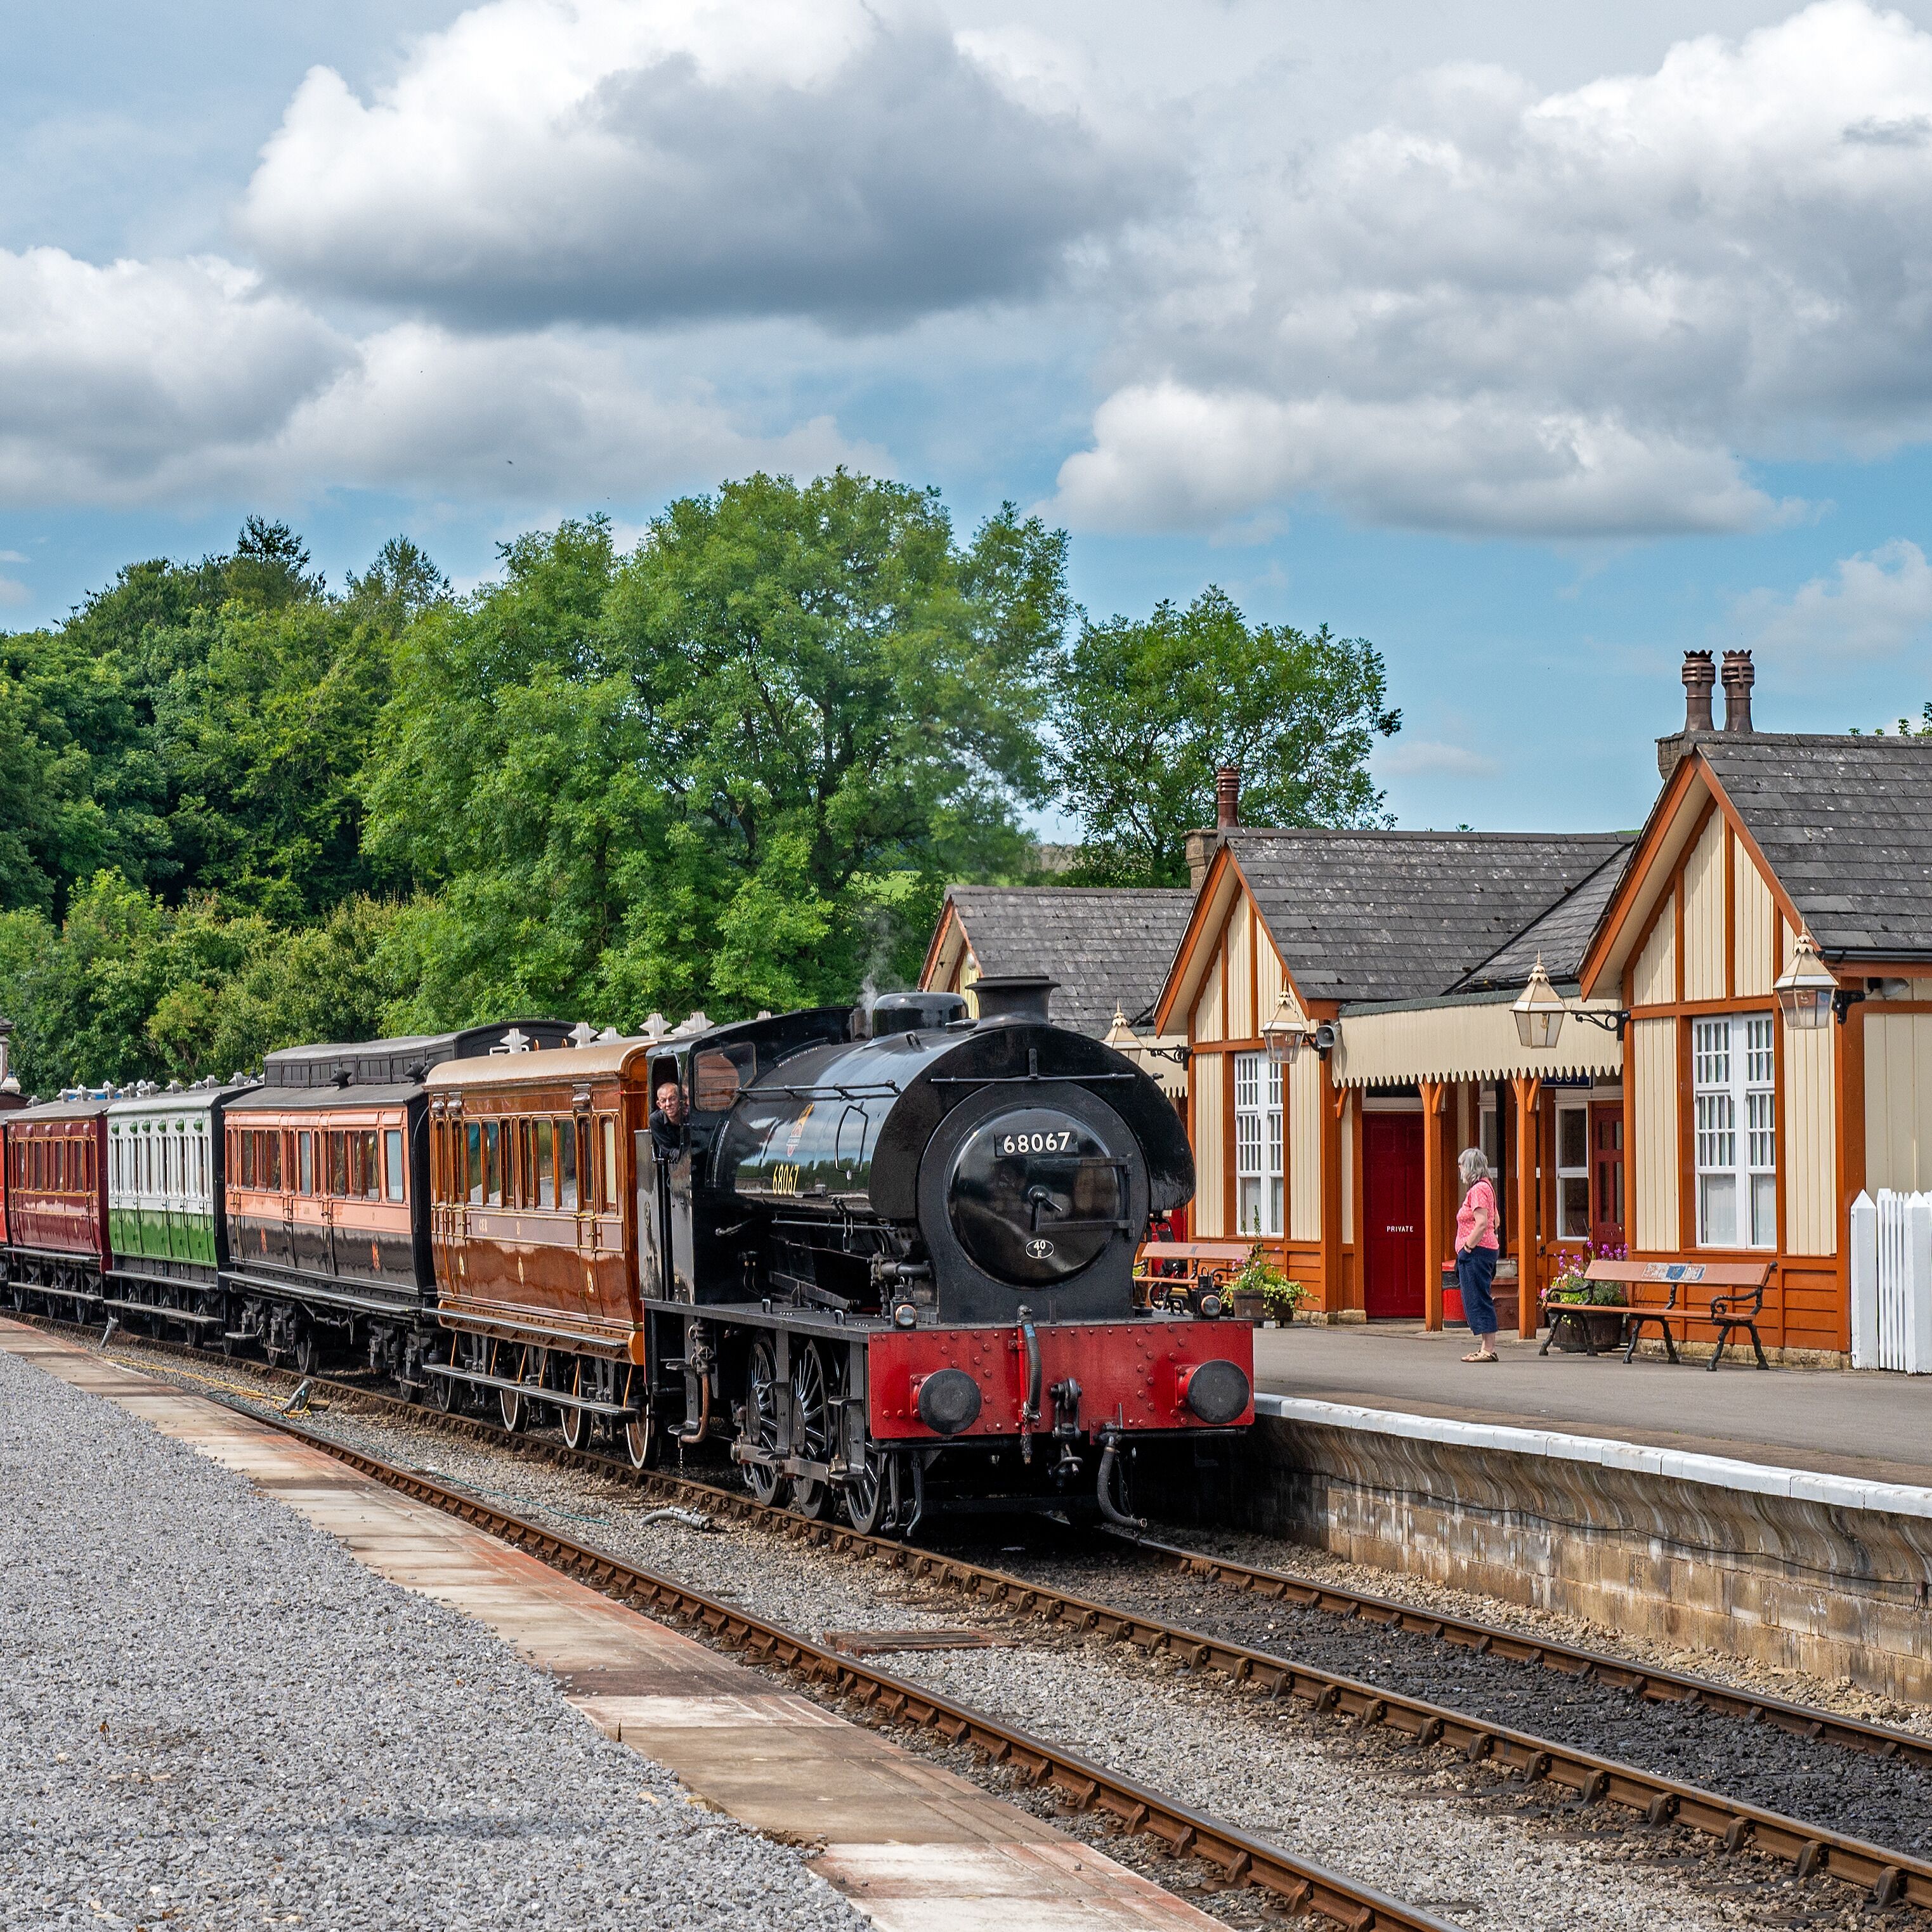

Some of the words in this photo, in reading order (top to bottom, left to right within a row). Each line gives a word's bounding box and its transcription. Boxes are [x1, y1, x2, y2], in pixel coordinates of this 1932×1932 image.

[1003, 1132, 1071, 1154] 68067
[773, 1163, 800, 1196] 68067
[1033, 1240, 1046, 1250] 40
